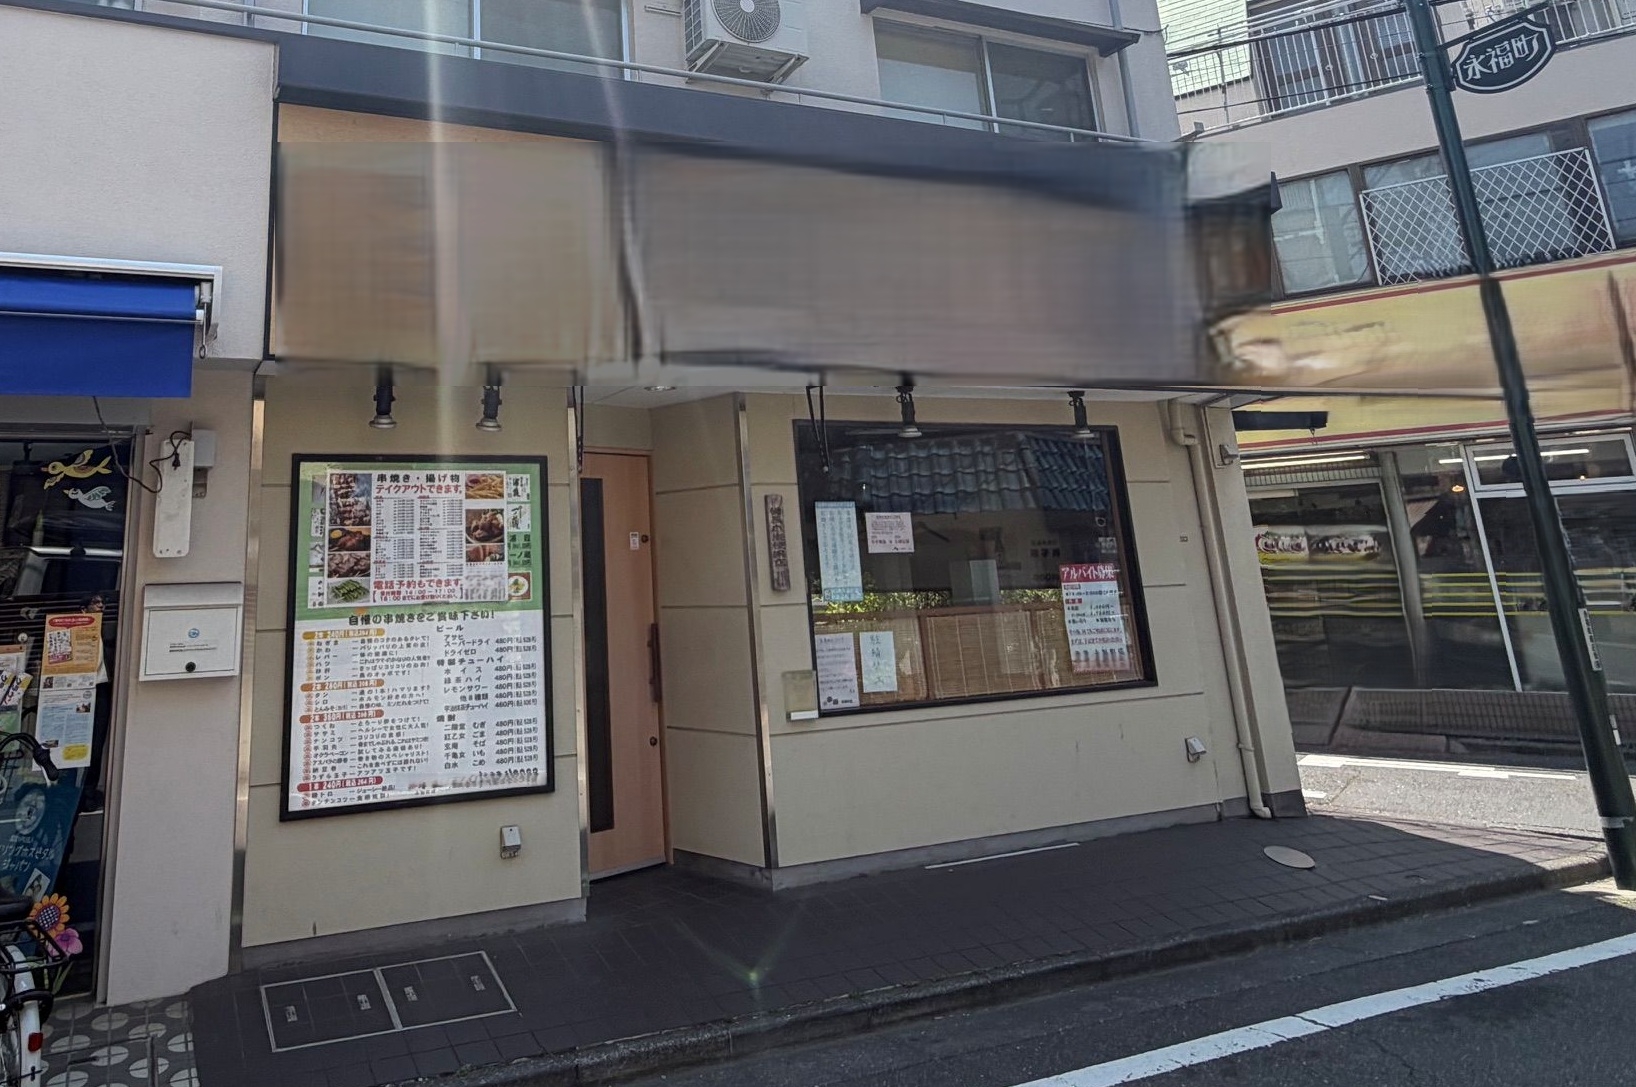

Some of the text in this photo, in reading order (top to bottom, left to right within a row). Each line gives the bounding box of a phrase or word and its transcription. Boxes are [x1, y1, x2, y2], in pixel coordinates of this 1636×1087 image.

[1463, 33, 1539, 81] 永福町
[377, 473, 460, 483] 串焼き・揚げ物
[376, 484, 462, 494] テイクアウトできます。
[436, 624, 464, 633] ビール
[444, 638, 491, 647] スーパードライ
[444, 649, 477, 657] ドライゼロ
[444, 685, 488, 694] レモンサワー
[473, 740, 486, 748] そば
[473, 759, 486, 767] こめ
